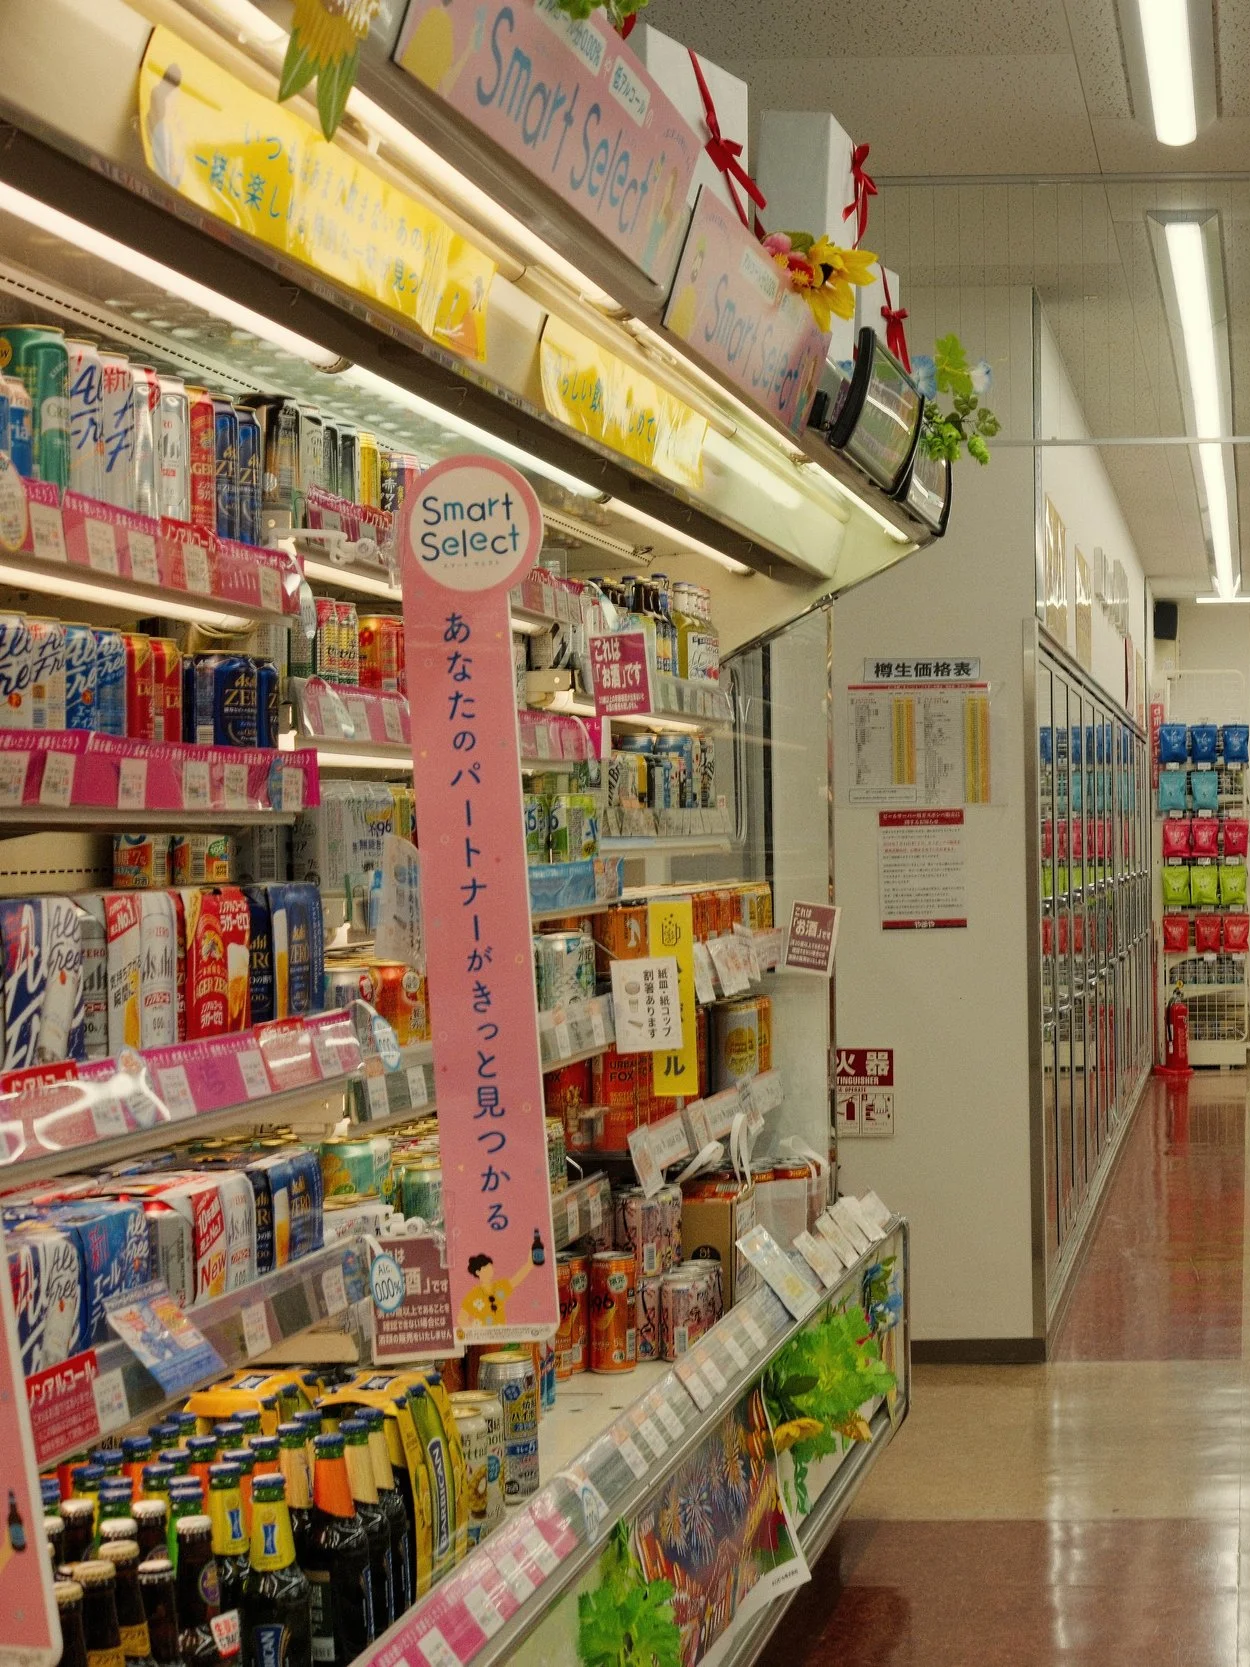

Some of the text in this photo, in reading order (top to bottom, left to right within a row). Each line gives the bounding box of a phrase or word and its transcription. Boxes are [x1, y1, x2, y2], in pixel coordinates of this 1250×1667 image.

[477, 7, 657, 234] Smart Select
[422, 492, 513, 526] Smart
[164, 523, 216, 551] ノンアルコール
[421, 523, 520, 561] Select
[594, 638, 621, 662] これは
[595, 662, 642, 689] 「お酒」です
[875, 662, 971, 679] 樽生価格表
[51, 903, 81, 942] All
[443, 612, 511, 1231] あなたのパートナーがきっと見つかる
[795, 906, 813, 918] これは
[793, 917, 832, 942] 「お酒」です
[142, 945, 173, 980] Asahi
[643, 969, 658, 1039] 割箸あります
[658, 967, 671, 1037] 紙皿・紙コップ
[836, 1050, 890, 1076] 火器
[836, 1076, 879, 1085] TINGUISHER
[201, 1252, 227, 1289] New
[382, 1319, 446, 1331] 確認できない場合には
[29, 1360, 96, 1407] ノンアルコール
